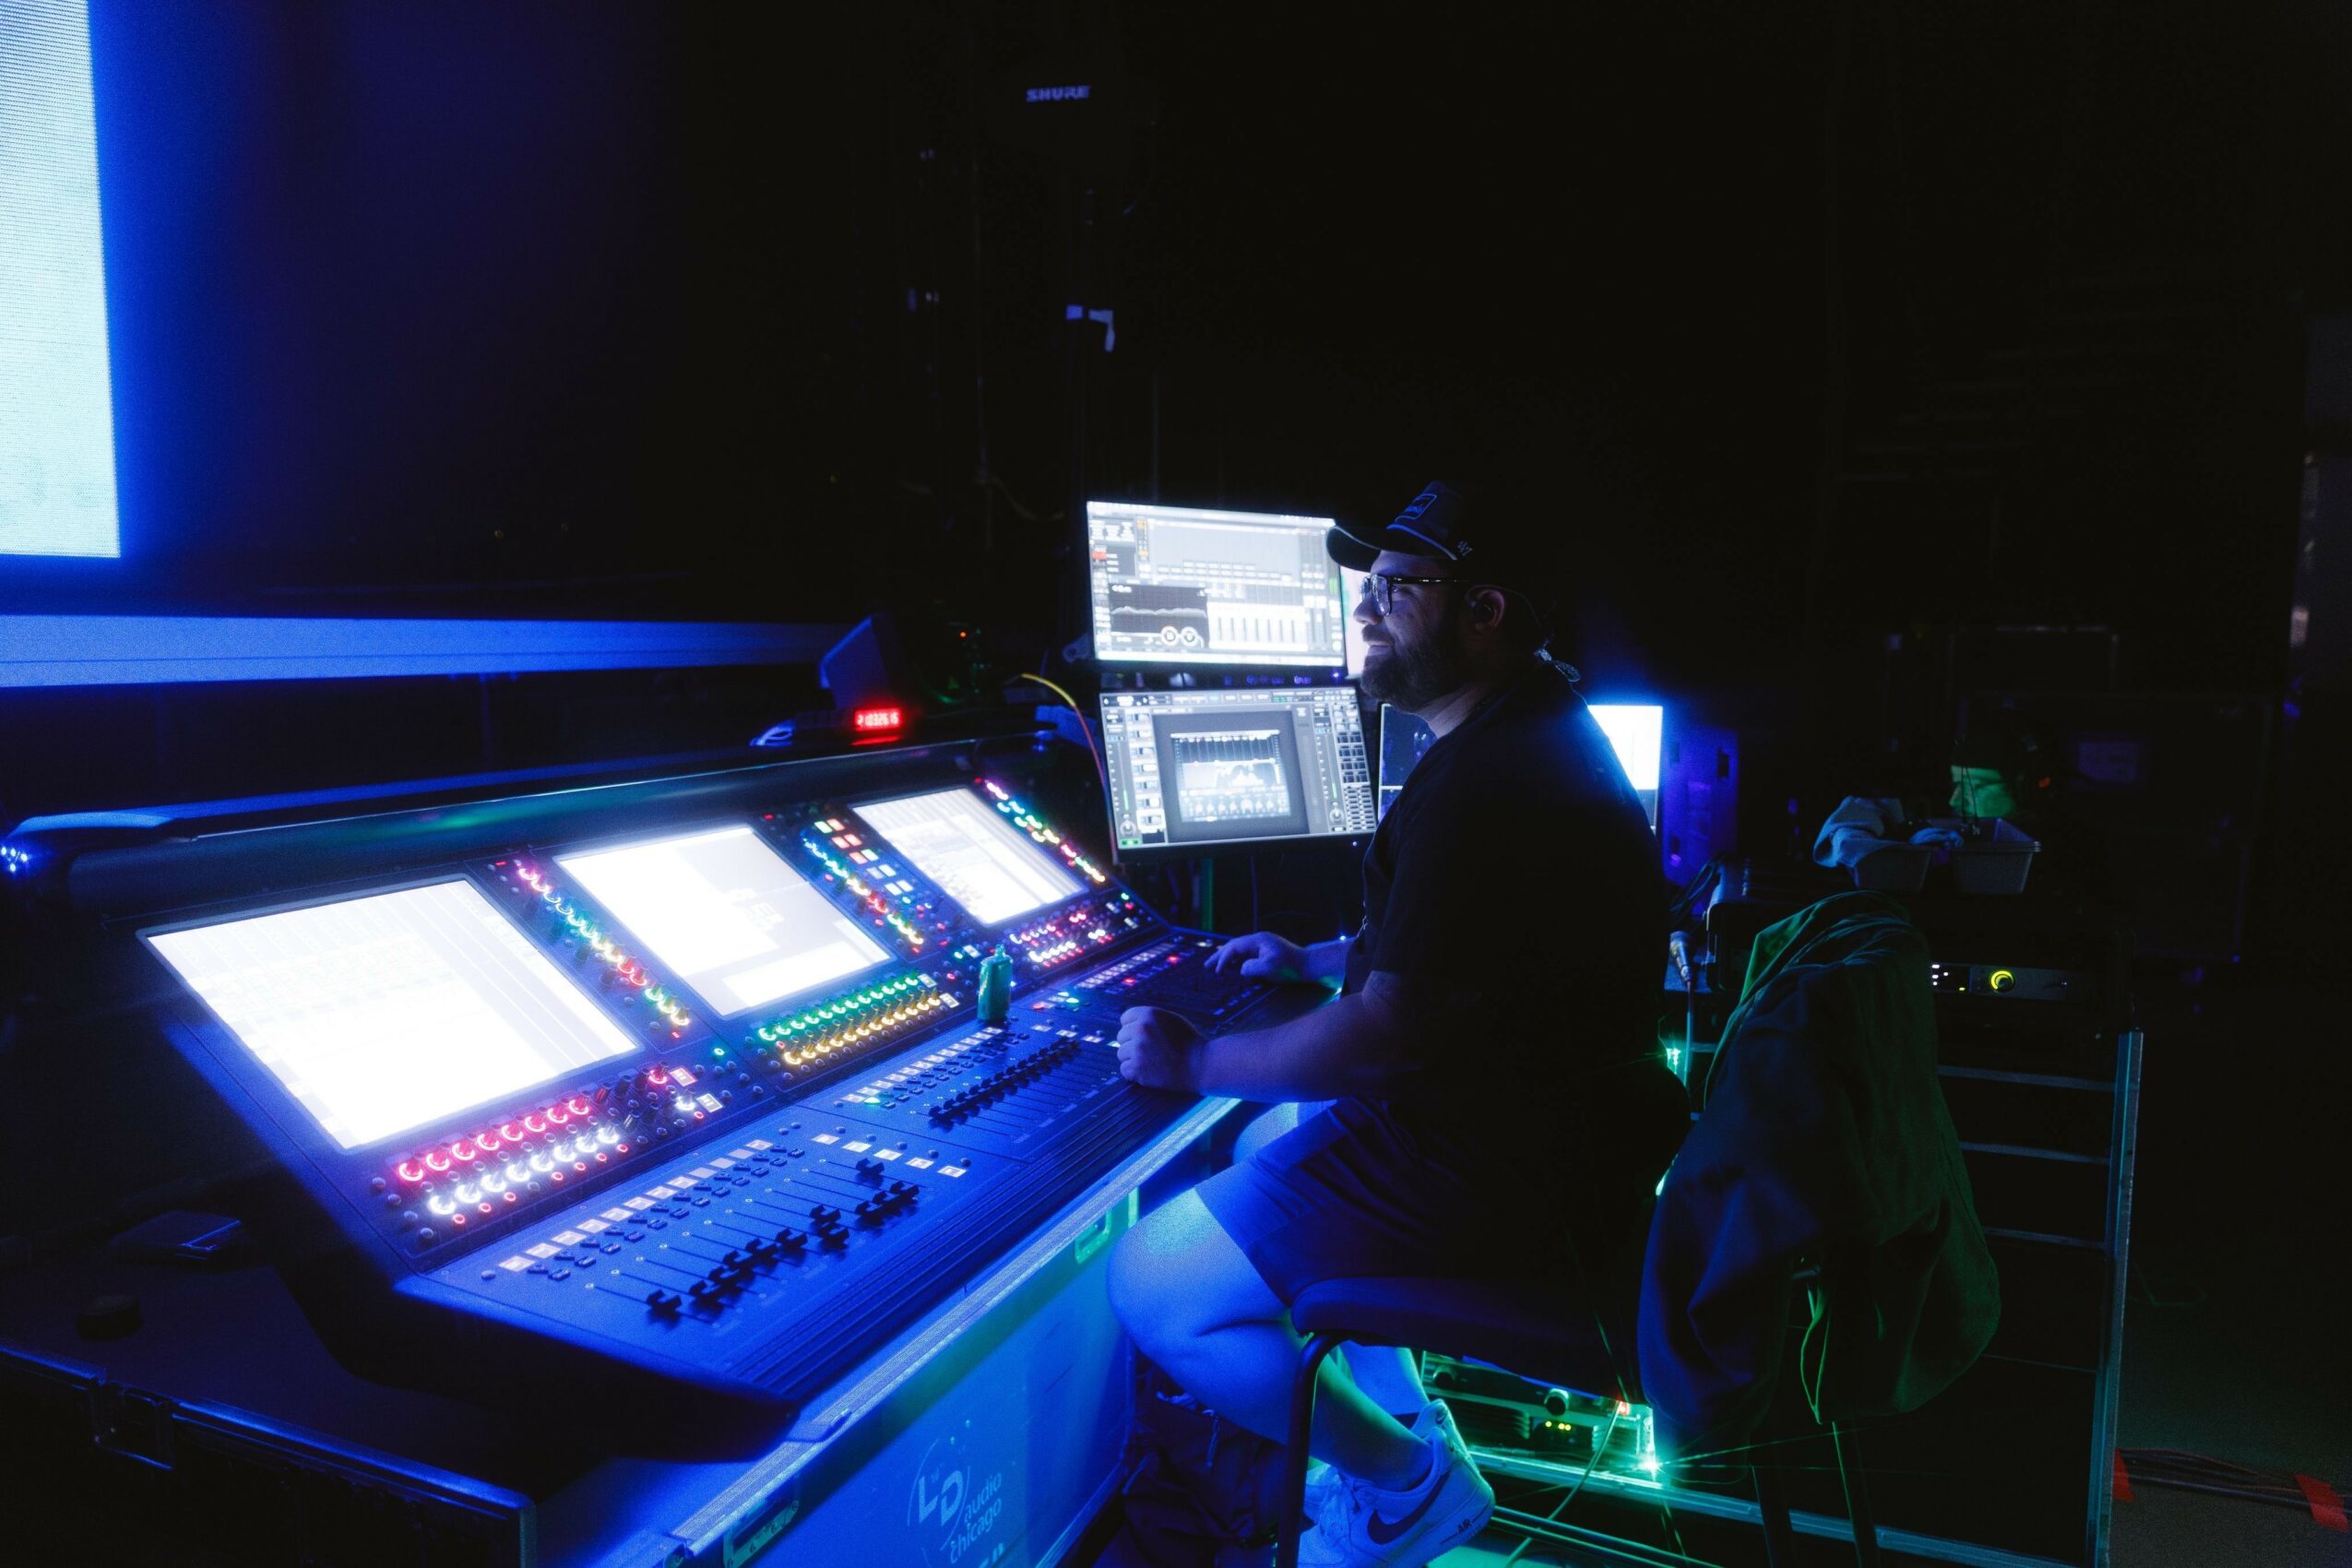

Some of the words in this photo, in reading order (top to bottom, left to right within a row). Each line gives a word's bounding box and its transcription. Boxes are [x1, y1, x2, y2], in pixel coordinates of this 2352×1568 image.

[1026, 84, 1091, 102] SHURE
[919, 1470, 964, 1526] LD
[964, 1472, 1003, 1523] audio
